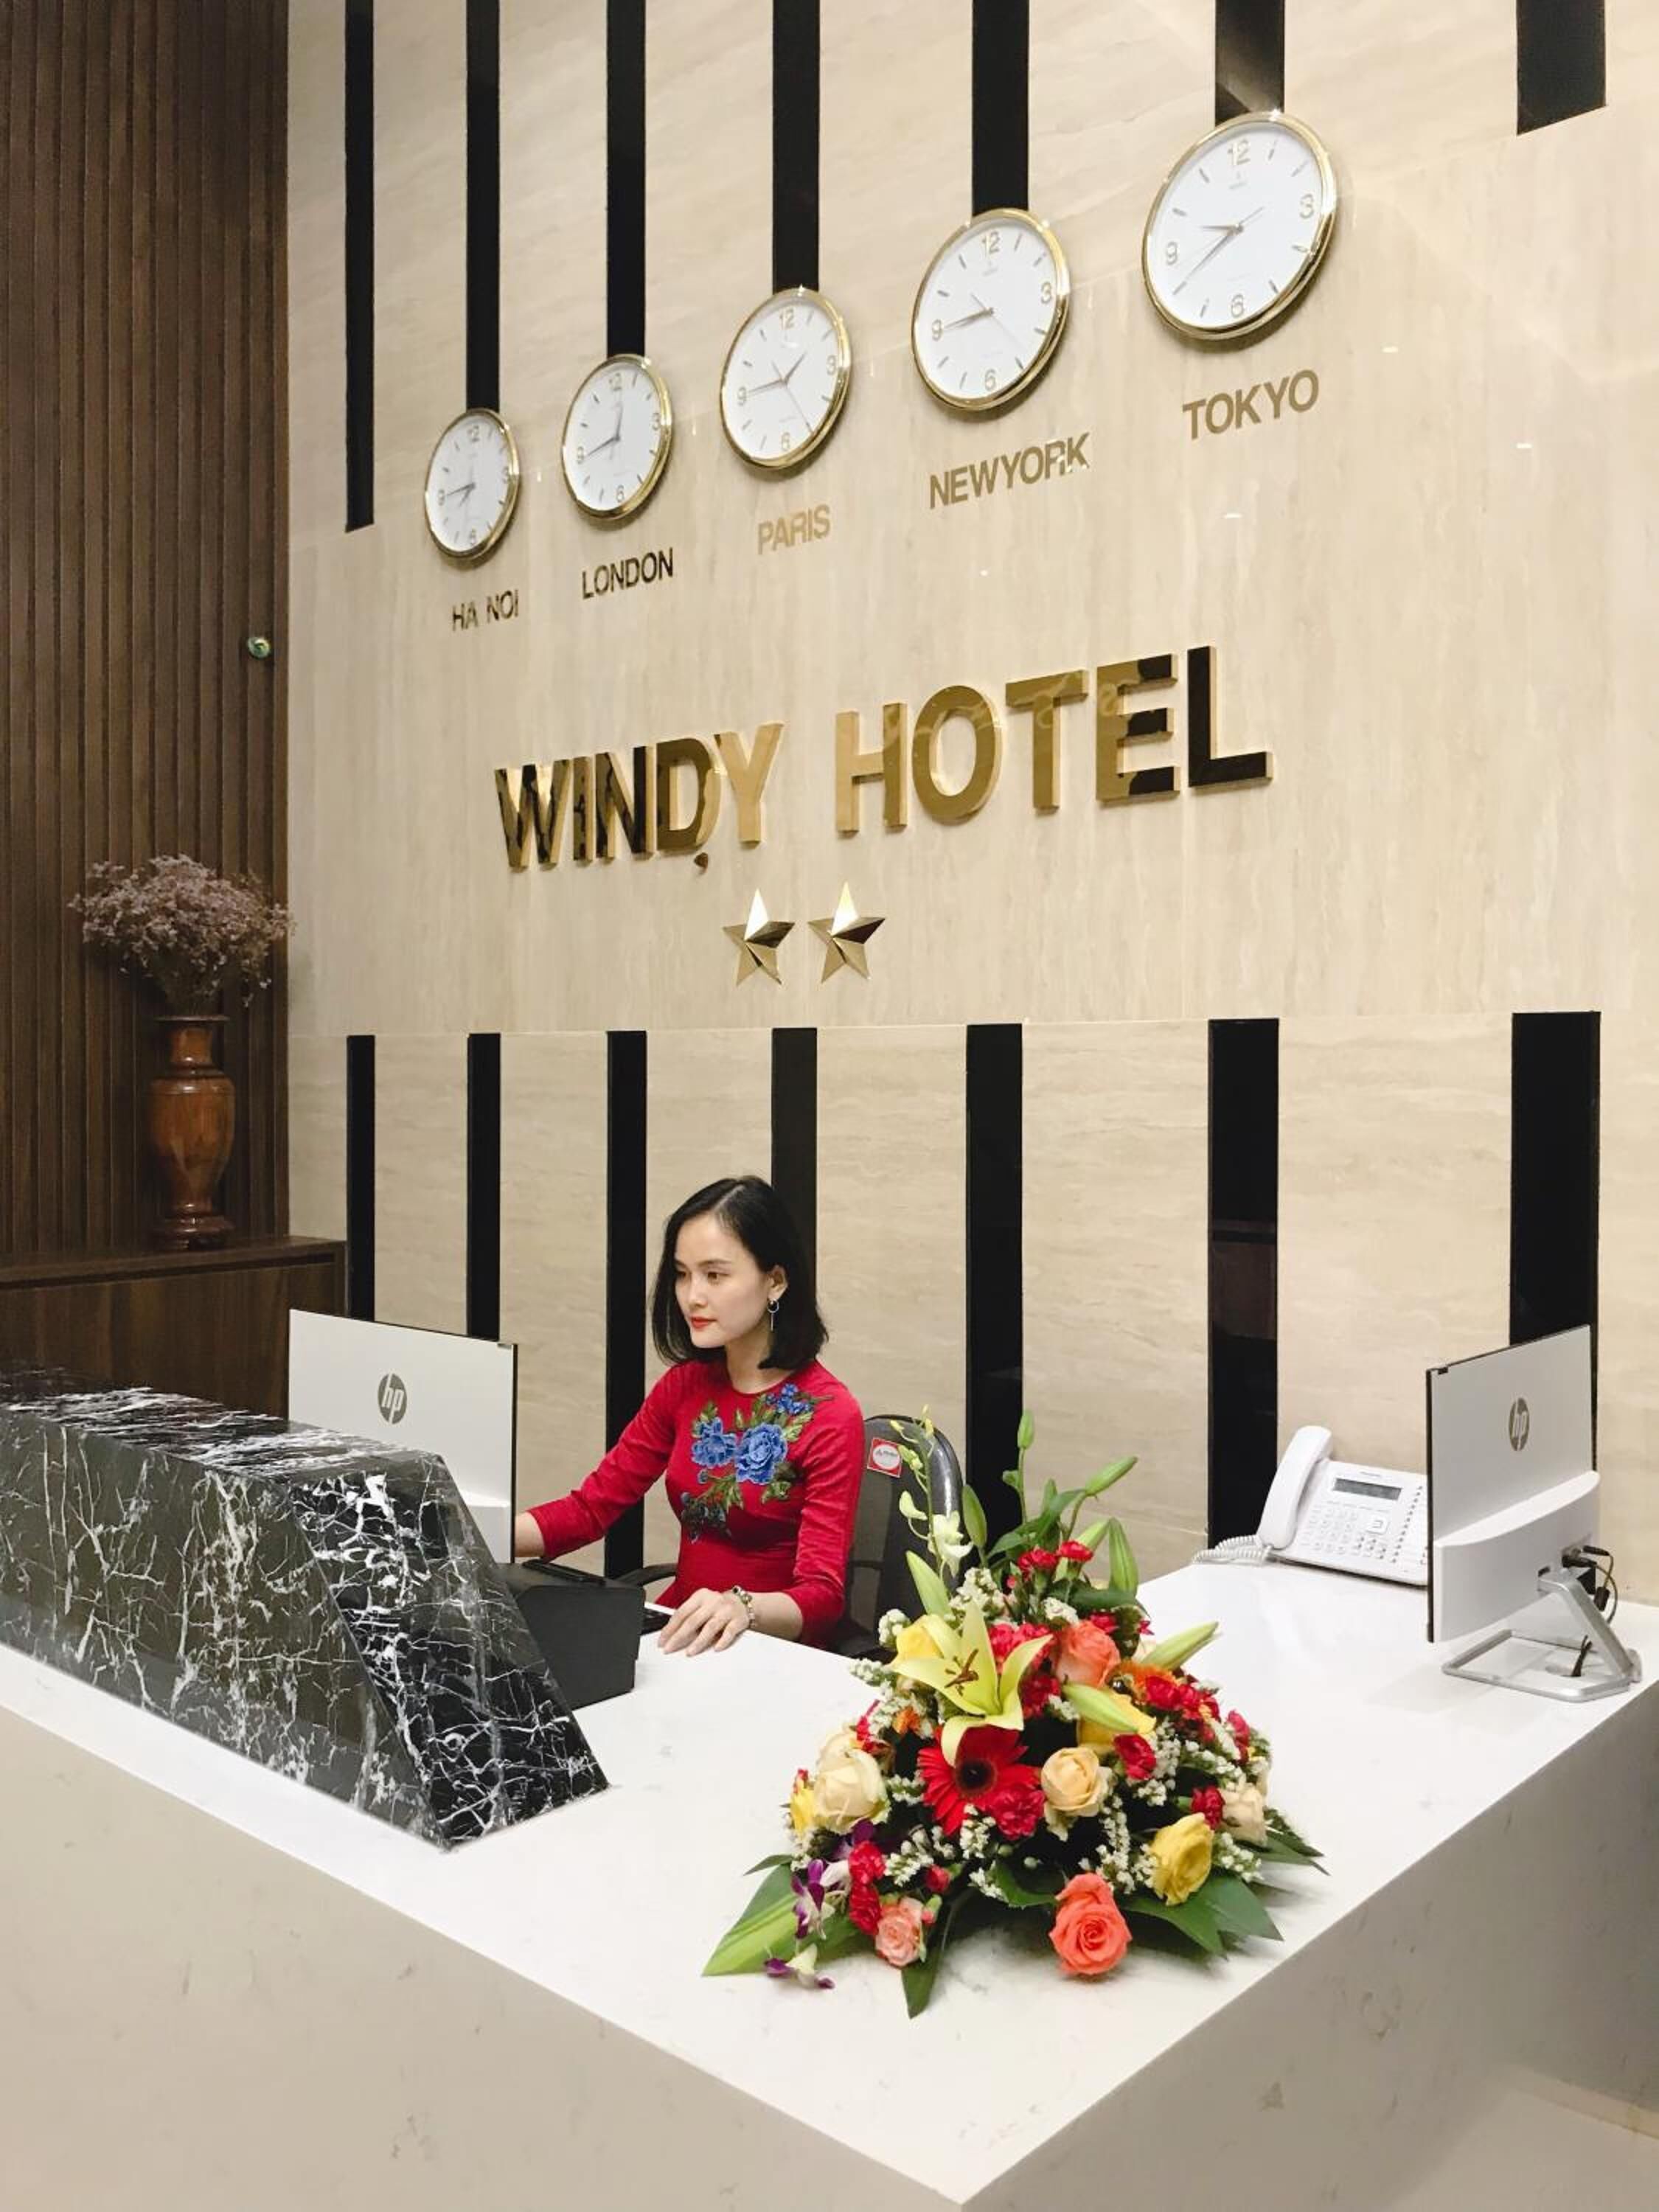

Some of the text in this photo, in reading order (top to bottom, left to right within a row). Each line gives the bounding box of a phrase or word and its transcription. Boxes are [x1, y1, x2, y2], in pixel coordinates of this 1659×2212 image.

[1228, 139, 1251, 166] 12
[1299, 193, 1315, 219] 3
[981, 231, 1000, 254] 12
[1165, 241, 1178, 265] 9
[1040, 282, 1052, 304] 3
[1231, 293, 1245, 318] 6
[779, 308, 794, 329] 12
[931, 319, 942, 341] 9
[827, 355, 837, 375] 3
[984, 369, 996, 391] 6
[737, 386, 747, 406] 9
[1182, 369, 1319, 440] TOKYO
[781, 431, 790, 451] 6
[930, 431, 1090, 509] NEWYORK
[757, 503, 830, 555] PARIS
[582, 547, 674, 599] LONDON
[452, 589, 518, 631] HA NOI
[495, 645, 1273, 871] WINDY HOTEL
[378, 1373, 407, 1425] hp
[1509, 1398, 1530, 1451] hp
